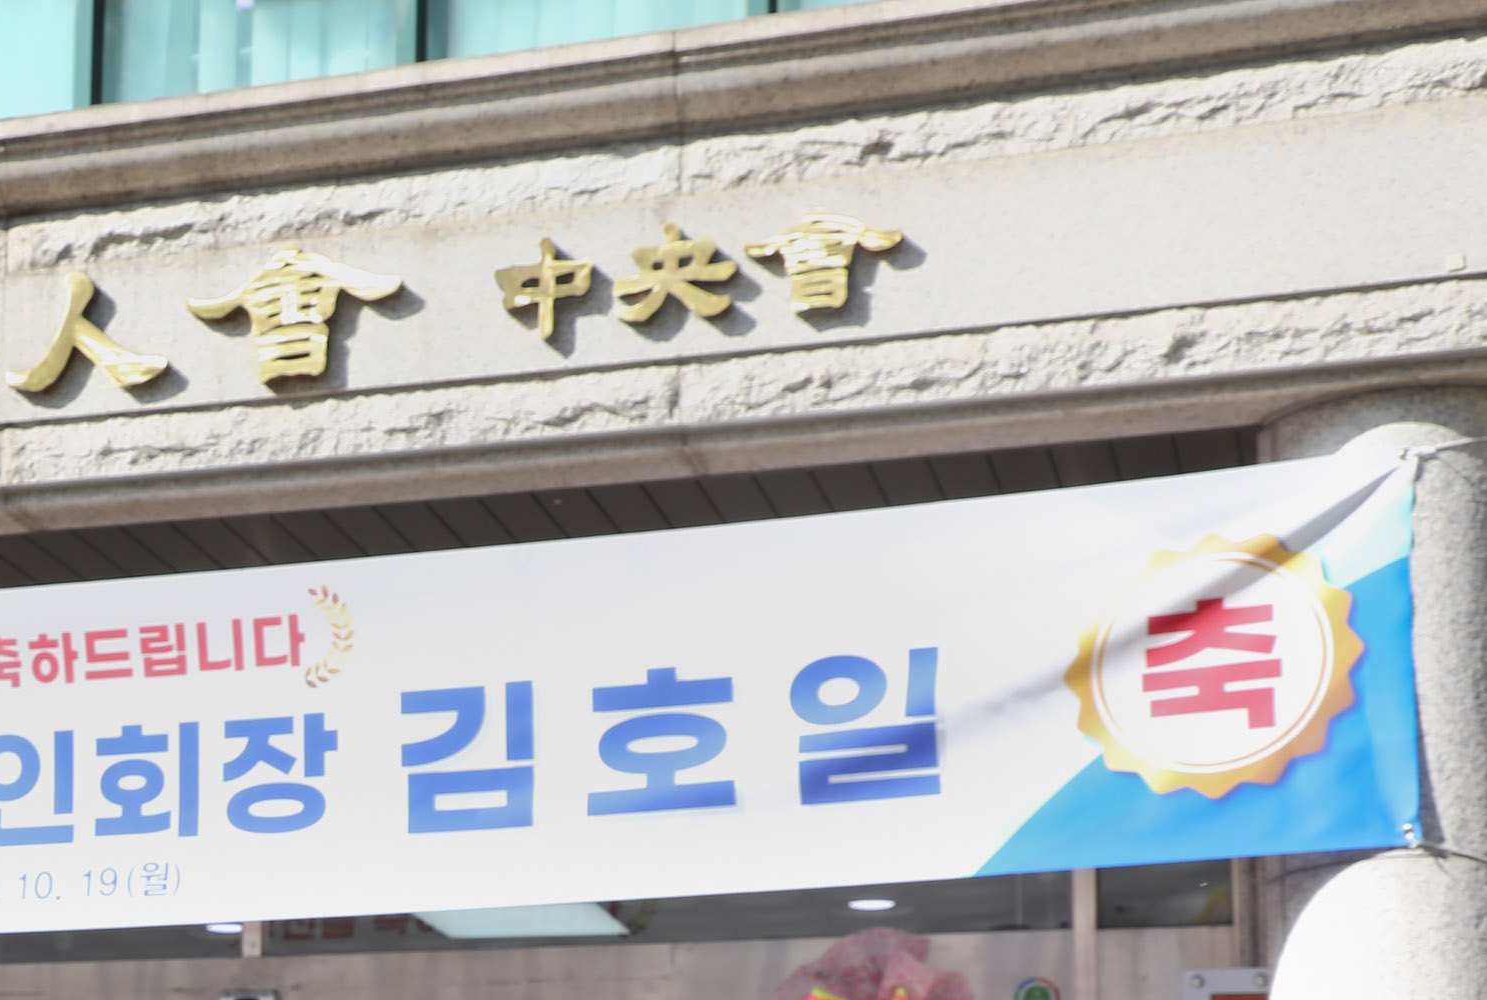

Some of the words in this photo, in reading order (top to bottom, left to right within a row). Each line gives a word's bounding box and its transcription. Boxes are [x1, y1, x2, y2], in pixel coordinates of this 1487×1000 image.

[494, 208, 902, 340] 中央會
[1140, 597, 1282, 730] 축
[18, 871, 62, 901] 10.
[82, 862, 183, 899] 19(월)
